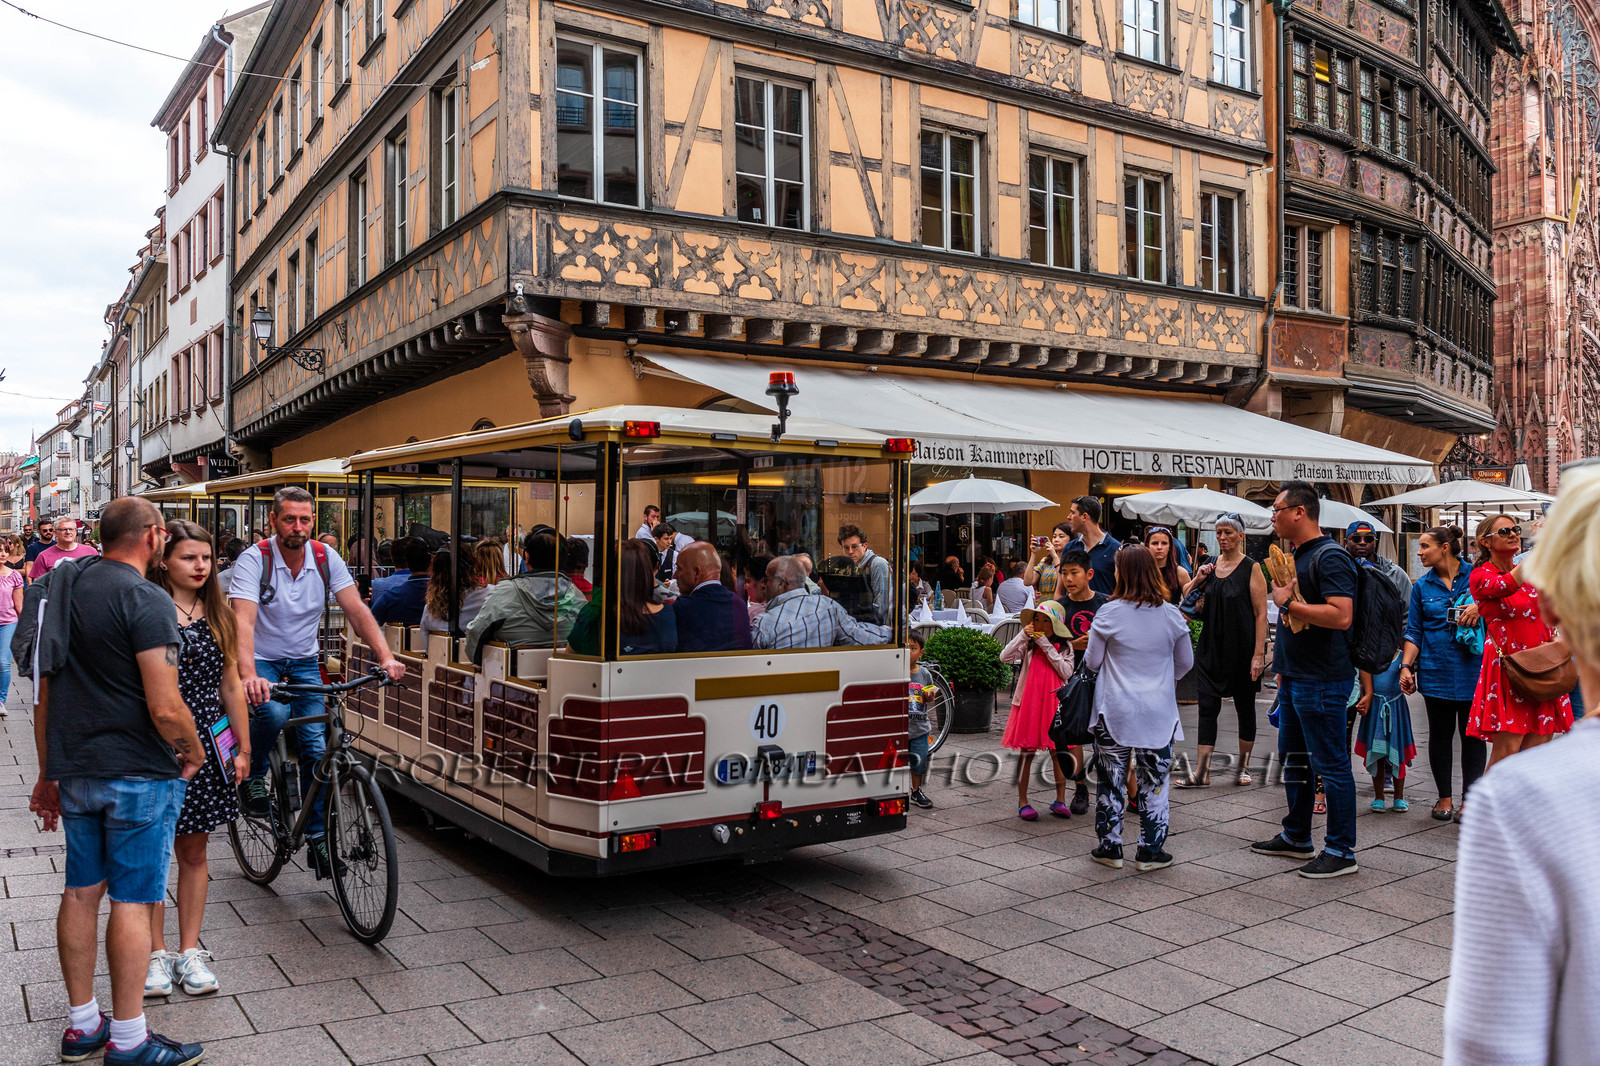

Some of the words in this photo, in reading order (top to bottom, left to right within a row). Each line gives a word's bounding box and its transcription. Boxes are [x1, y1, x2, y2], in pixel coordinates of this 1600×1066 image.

[968, 444, 1055, 467] Kammerzell
[1082, 448, 1142, 472] HOTEL
[1151, 453, 1163, 473] &
[1172, 454, 1275, 478] RESTAURANT
[1293, 463, 1333, 479] Maison
[1335, 464, 1394, 481] Kammerzell
[754, 703, 779, 739] 40
